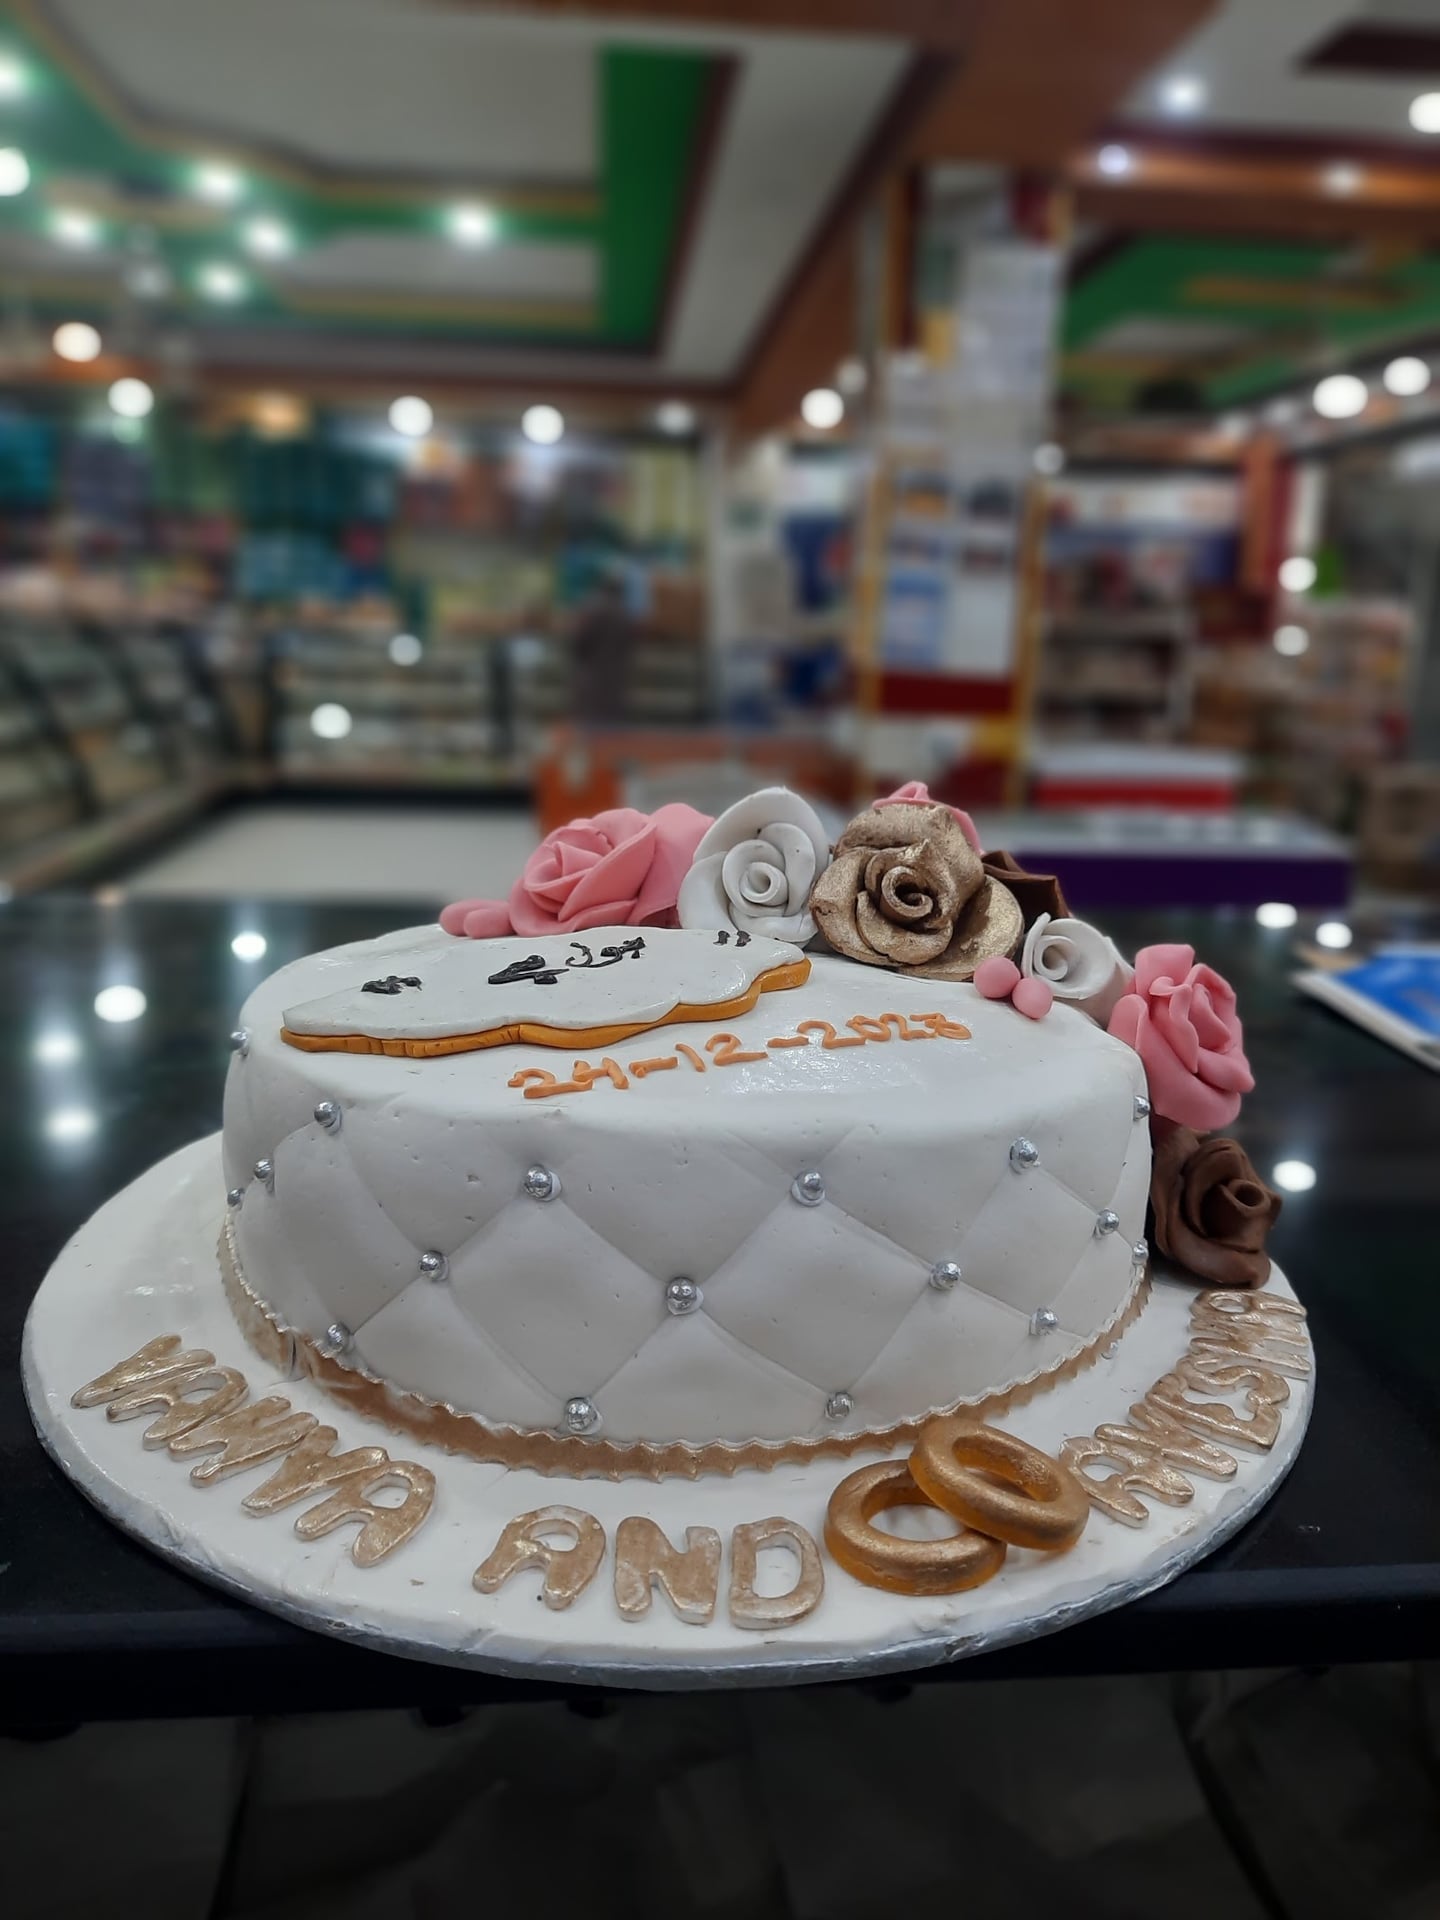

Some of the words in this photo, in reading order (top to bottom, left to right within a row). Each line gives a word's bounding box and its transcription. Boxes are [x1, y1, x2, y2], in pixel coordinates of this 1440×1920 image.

[71, 1333, 436, 1568] YAHYA
[472, 1504, 825, 1630] AND
[1059, 1288, 1312, 1529] AYESHA
